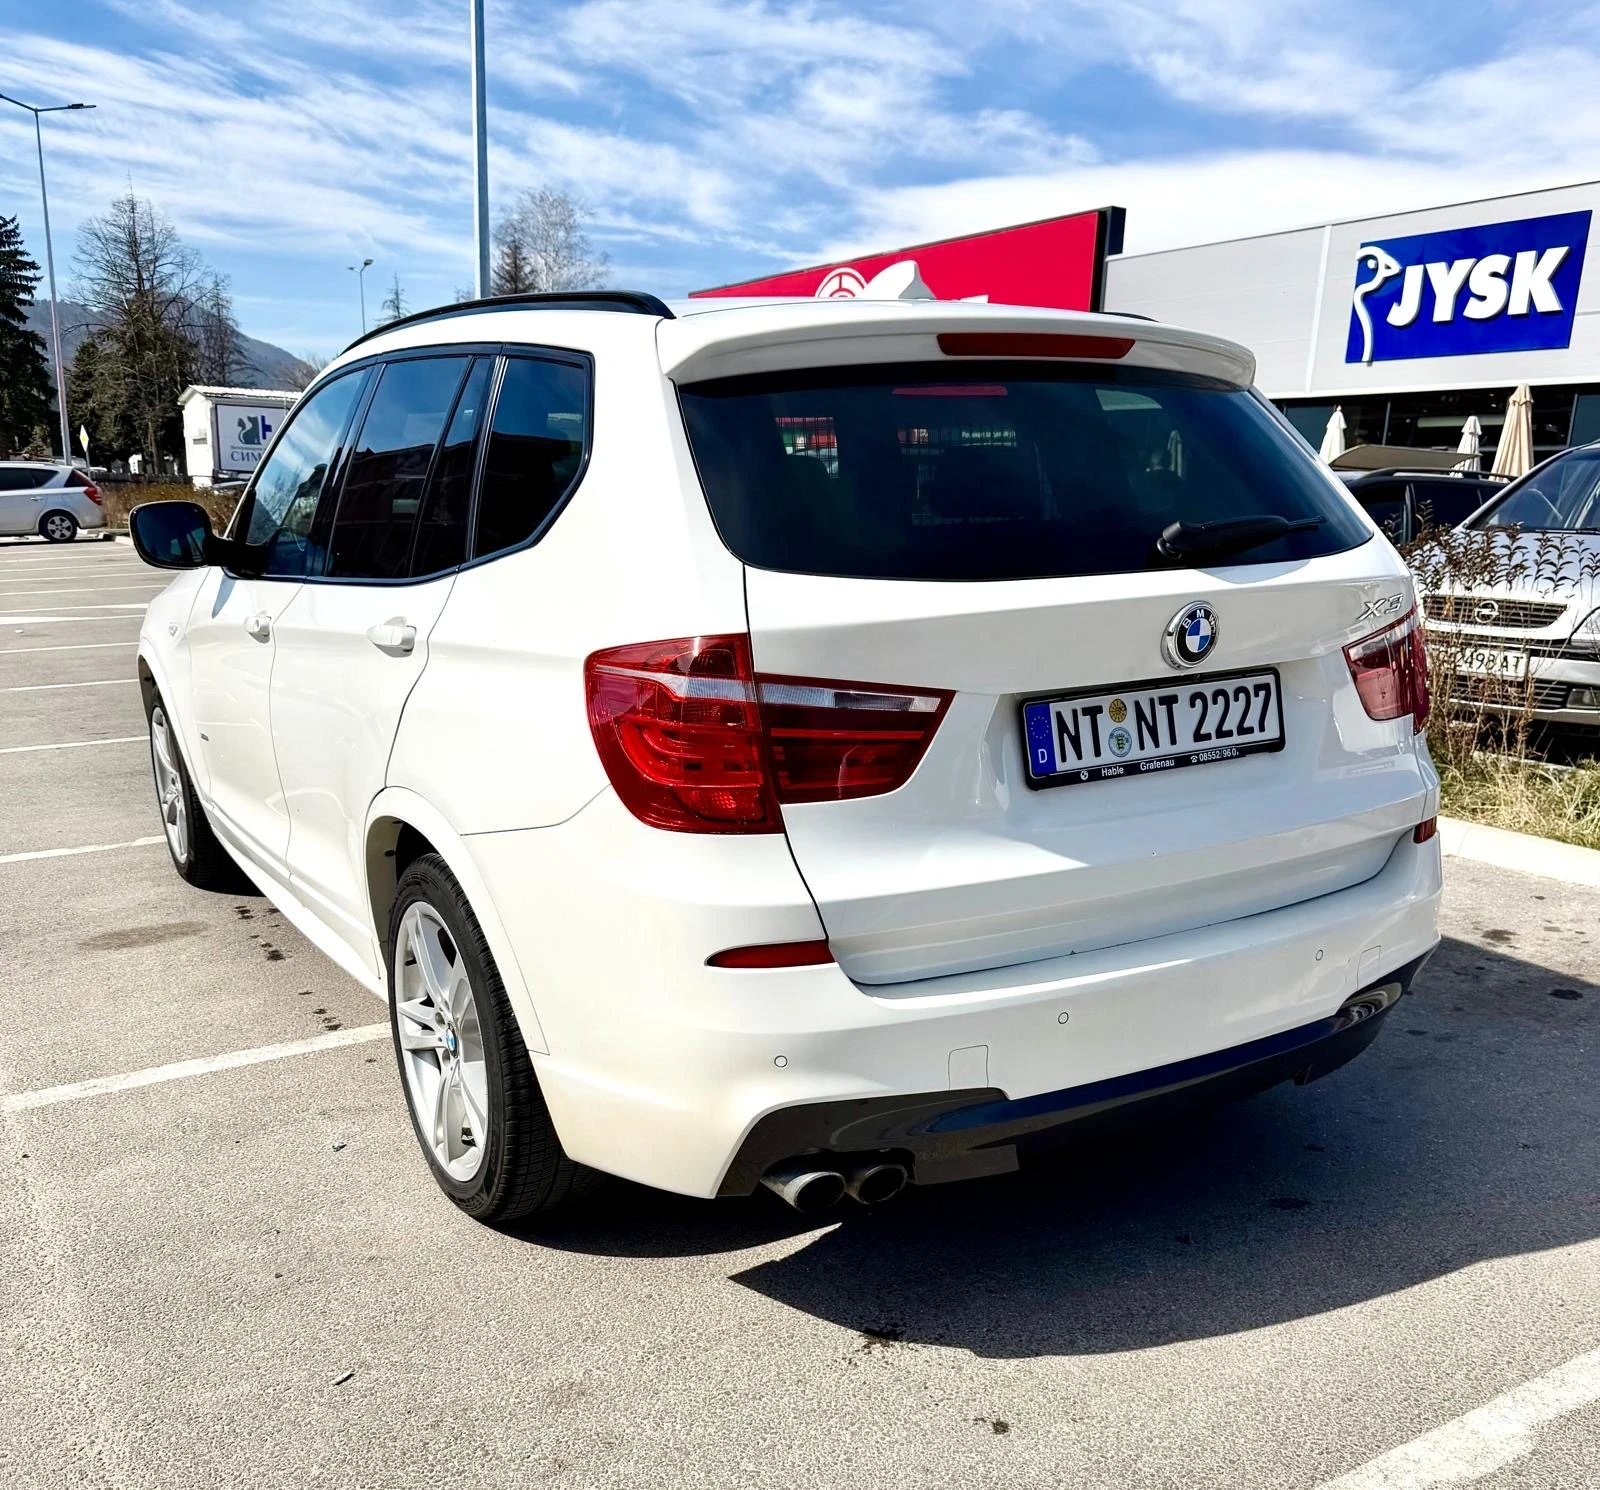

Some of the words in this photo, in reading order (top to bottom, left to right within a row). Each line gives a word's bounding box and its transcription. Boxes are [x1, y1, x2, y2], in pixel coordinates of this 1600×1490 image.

[1386, 246, 1570, 327] JYSK
[1356, 593, 1404, 620] X3
[1182, 609, 1217, 630] BMW
[1055, 704, 1104, 763] NT
[1134, 694, 1179, 751] NT
[1189, 682, 1272, 743] 2227
[1038, 748, 1048, 764] D
[1101, 766, 1125, 777] Hable
[1140, 758, 1175, 772] Grafenau
